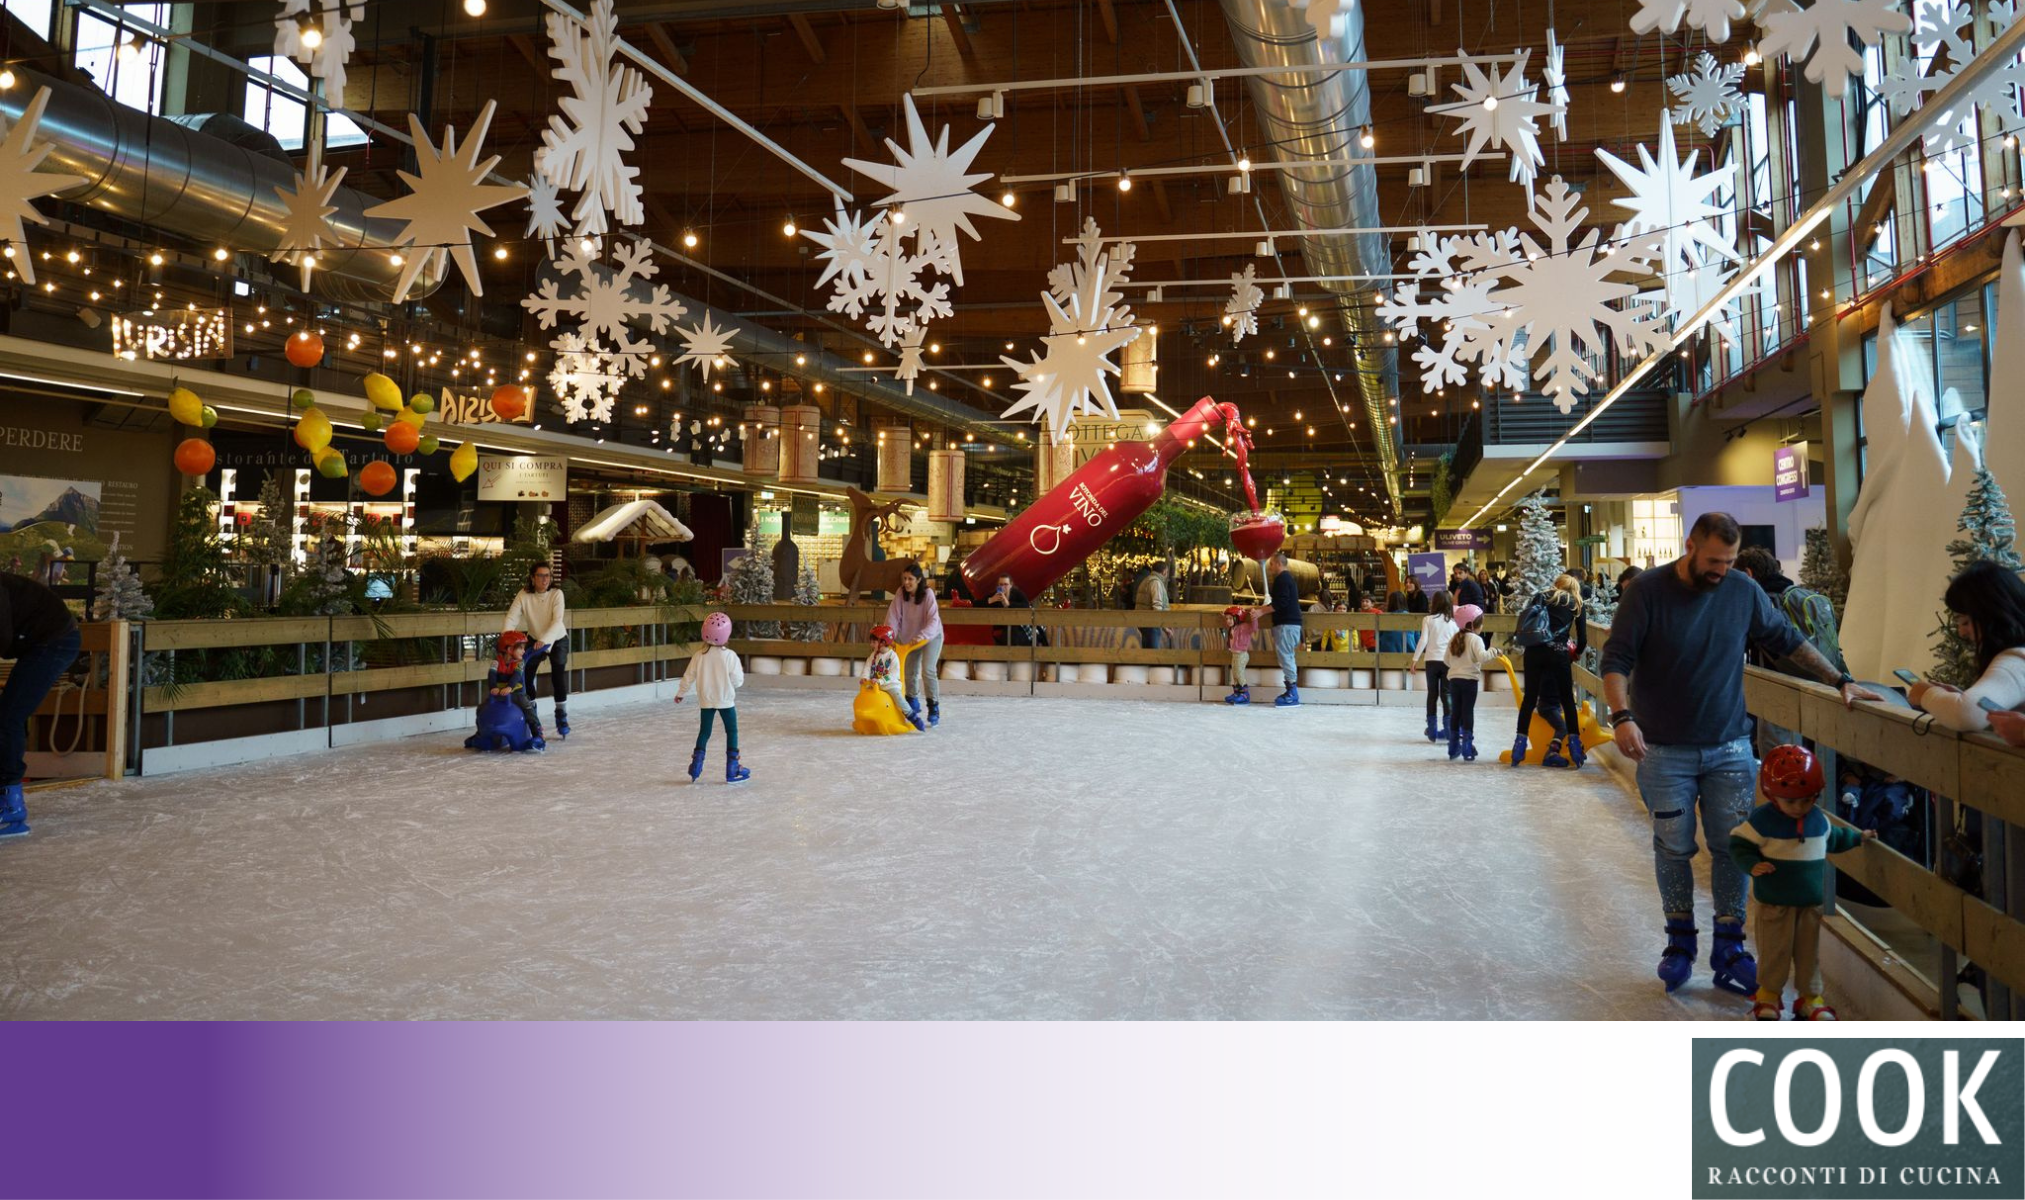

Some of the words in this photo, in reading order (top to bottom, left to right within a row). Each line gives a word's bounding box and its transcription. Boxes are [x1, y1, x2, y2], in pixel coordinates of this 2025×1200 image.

[1066, 423, 1145, 441] OTTEGA
[216, 450, 297, 466] storante
[483, 461, 501, 472] QUI
[505, 461, 515, 470] SI
[519, 461, 563, 471] COMPRA
[1069, 486, 1102, 527] VINO
